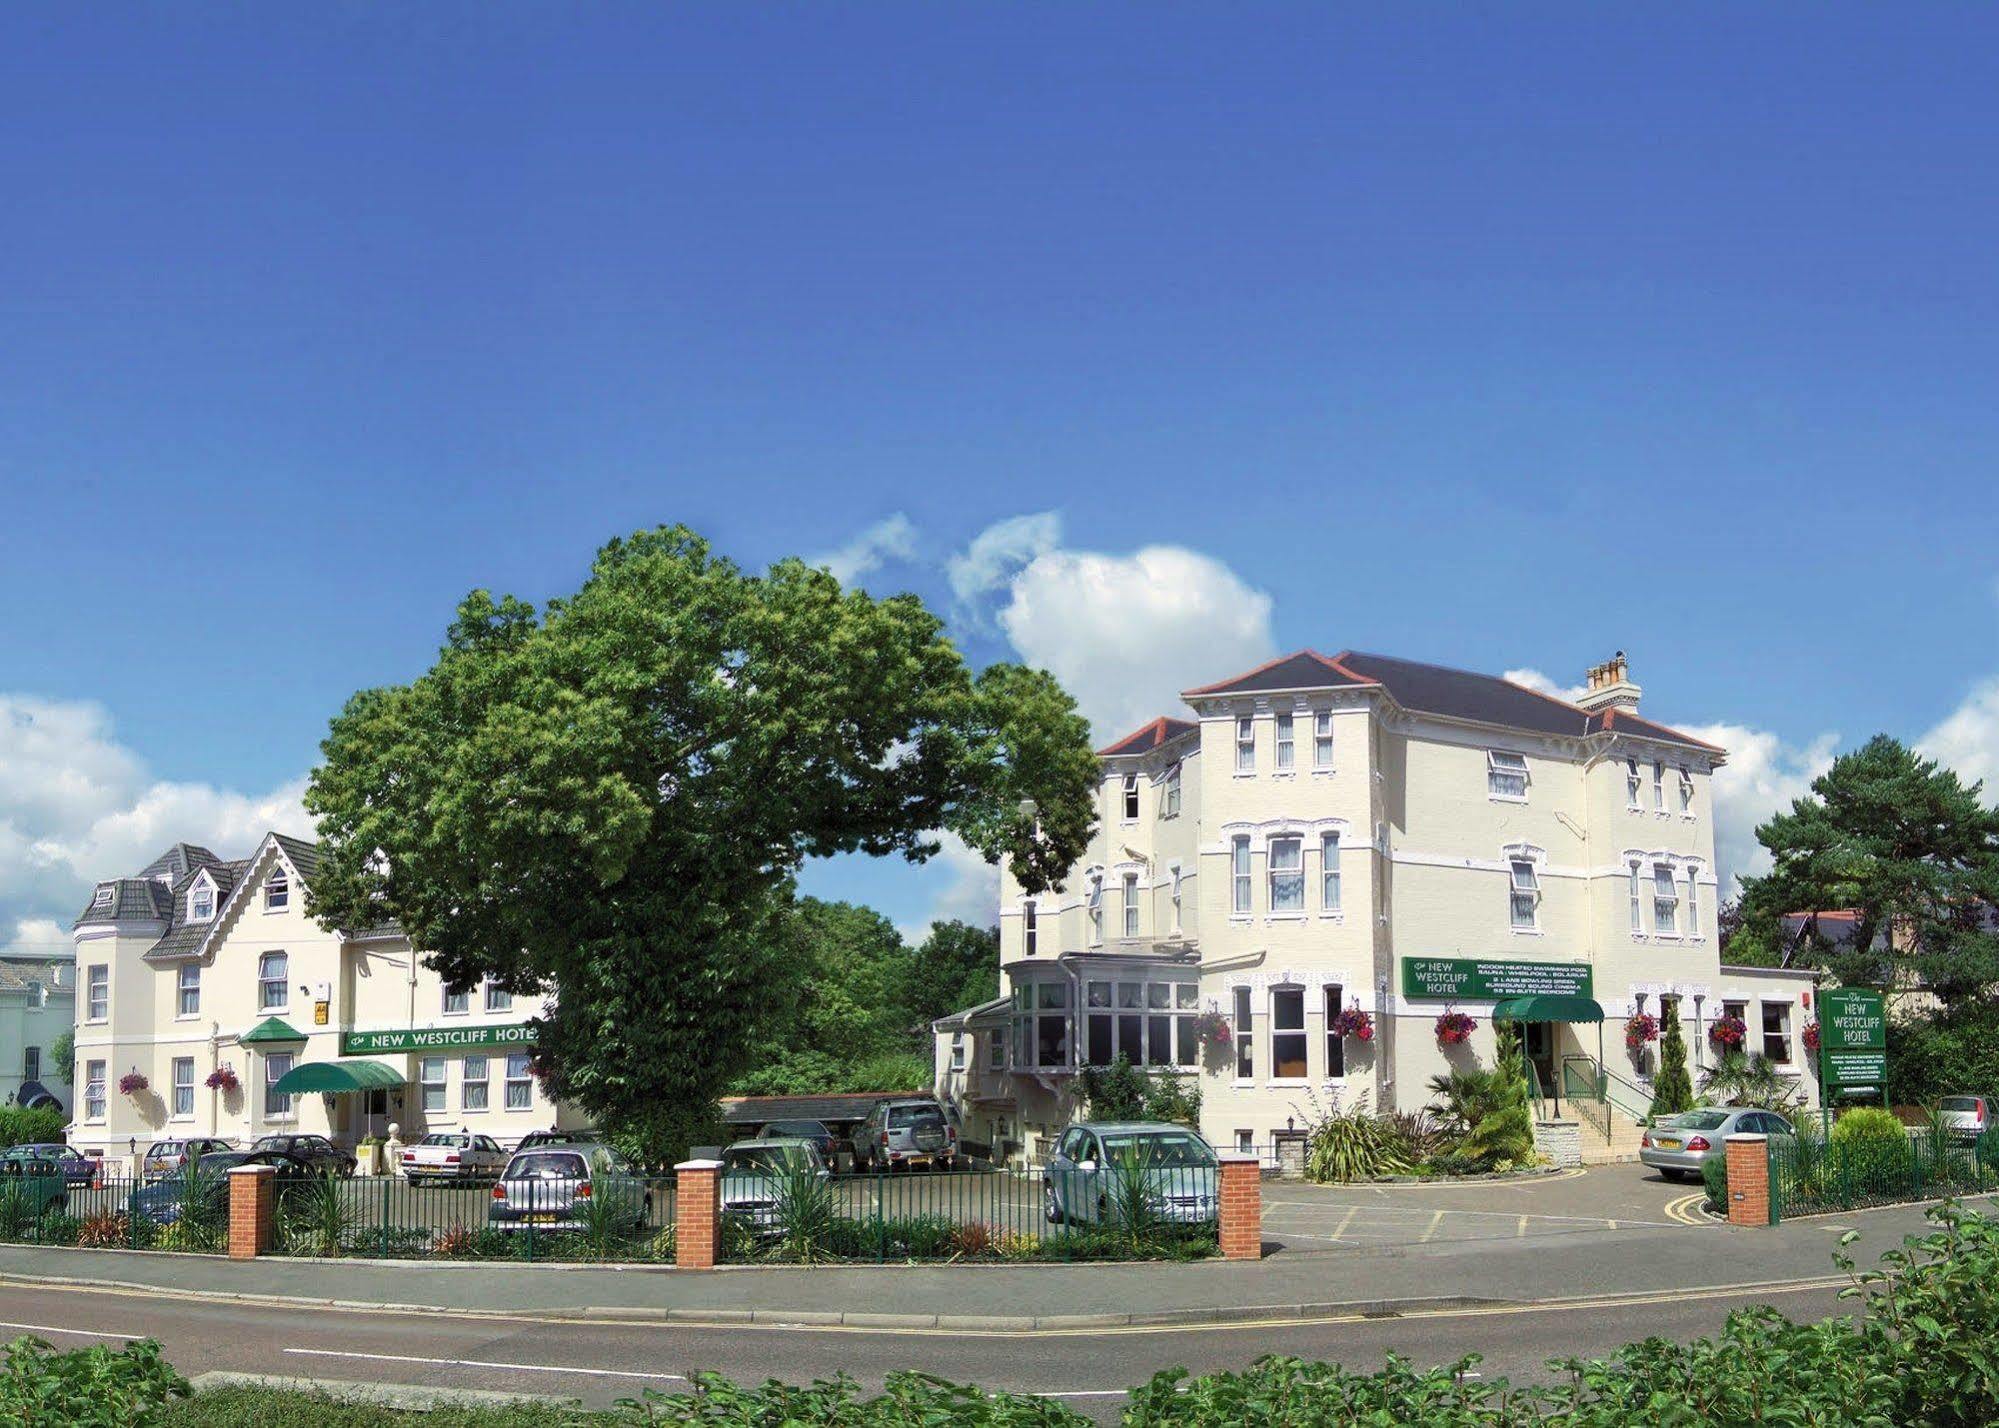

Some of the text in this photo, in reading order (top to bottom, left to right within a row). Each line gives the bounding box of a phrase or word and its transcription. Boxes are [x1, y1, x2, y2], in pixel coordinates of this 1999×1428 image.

[1428, 963, 1452, 972] NEW
[1415, 972, 1468, 983] WESTCLIFF
[1426, 983, 1457, 993] HOTEL
[1844, 1003, 1866, 1014] NEW
[1834, 1016, 1880, 1028] WESTCLIFF
[371, 1034, 405, 1047] NEW
[412, 1029, 488, 1045] WESTCLIFF
[1843, 1030, 1871, 1041] HOTEL
